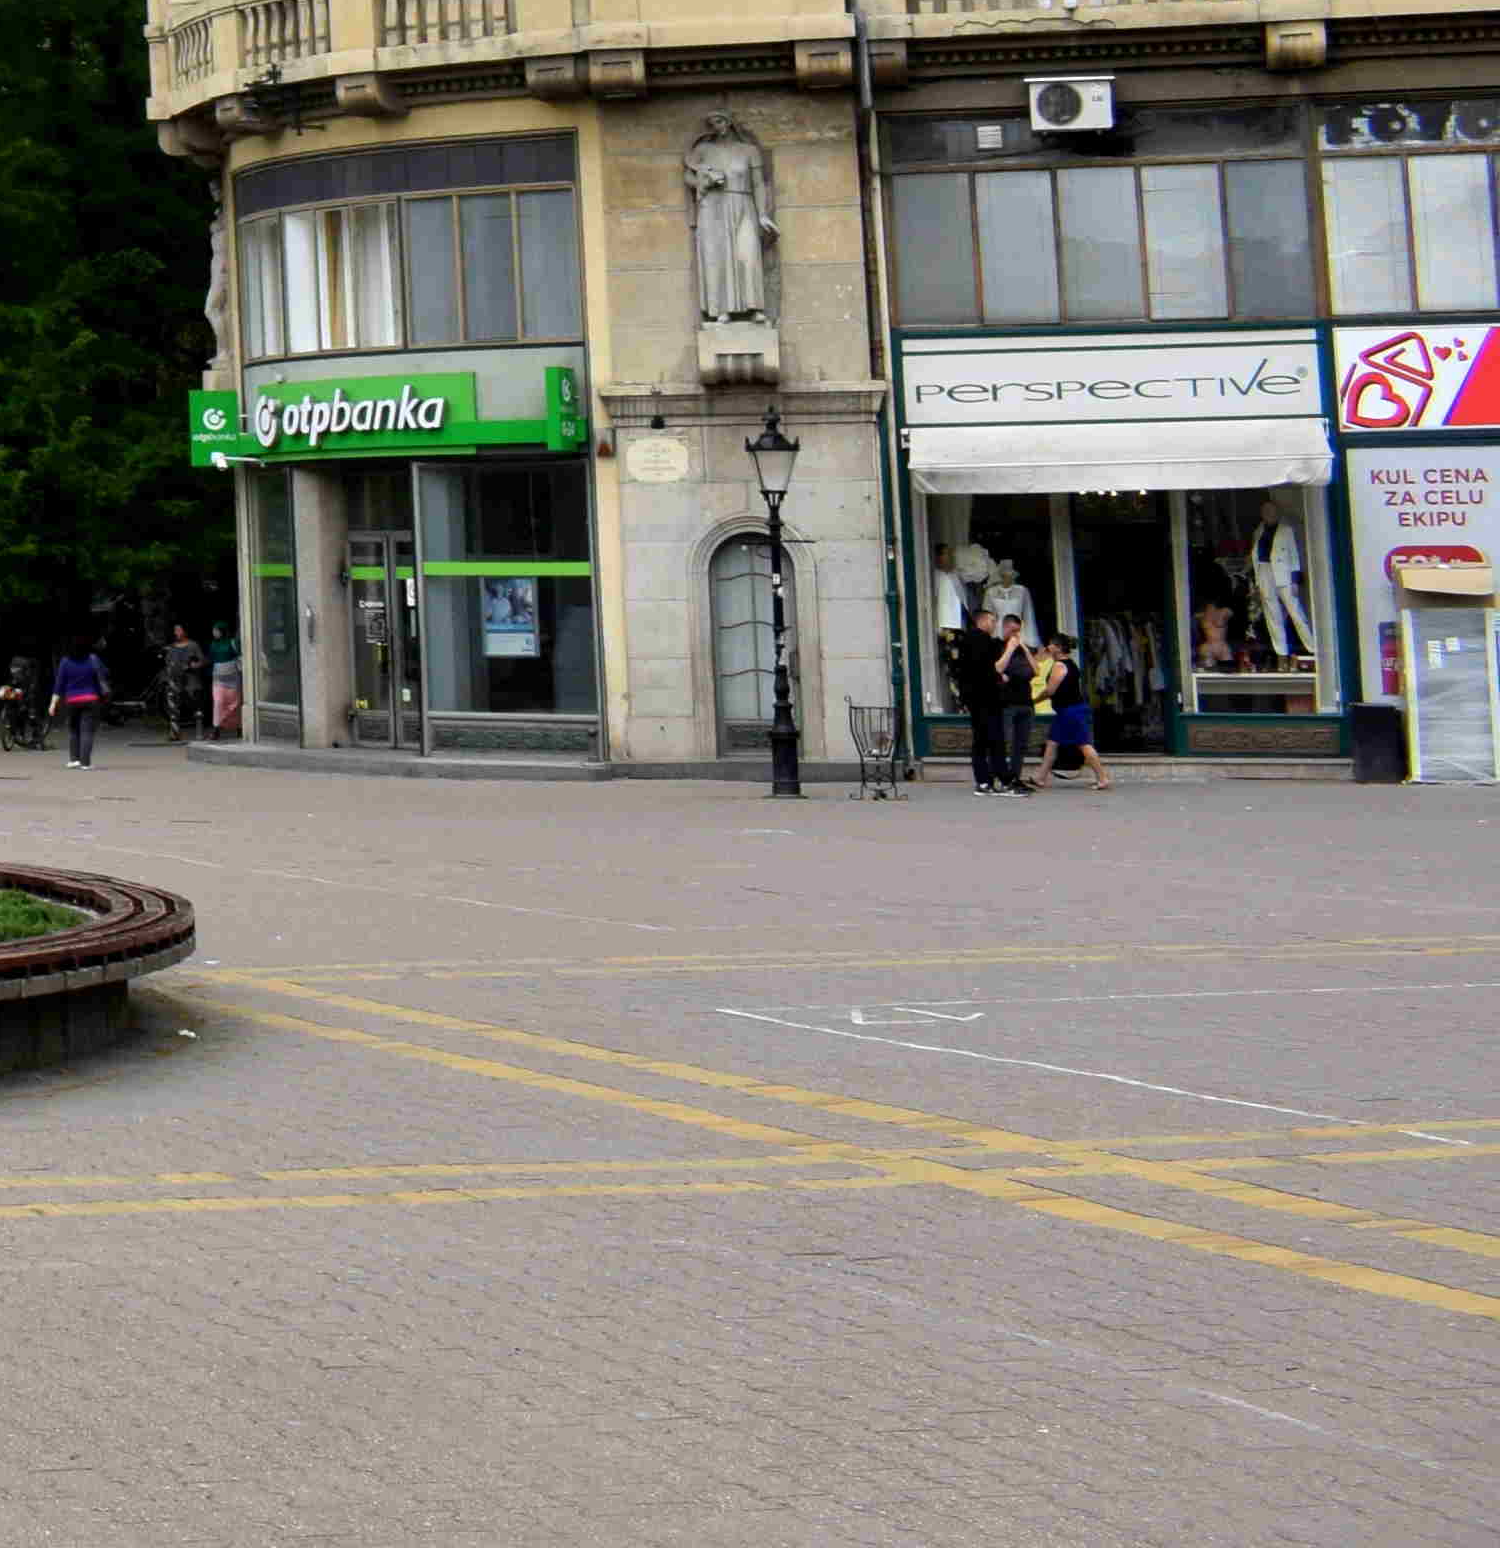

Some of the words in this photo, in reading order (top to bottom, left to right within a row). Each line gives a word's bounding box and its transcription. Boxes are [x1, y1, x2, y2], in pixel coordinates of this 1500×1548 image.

[282, 384, 444, 446] otpbanka
[1371, 468, 1416, 485] KUL
[1423, 467, 1490, 485] CENA
[1384, 490, 1417, 506] ZA
[1424, 489, 1484, 506] CELU
[1398, 511, 1467, 528] EKIPU
